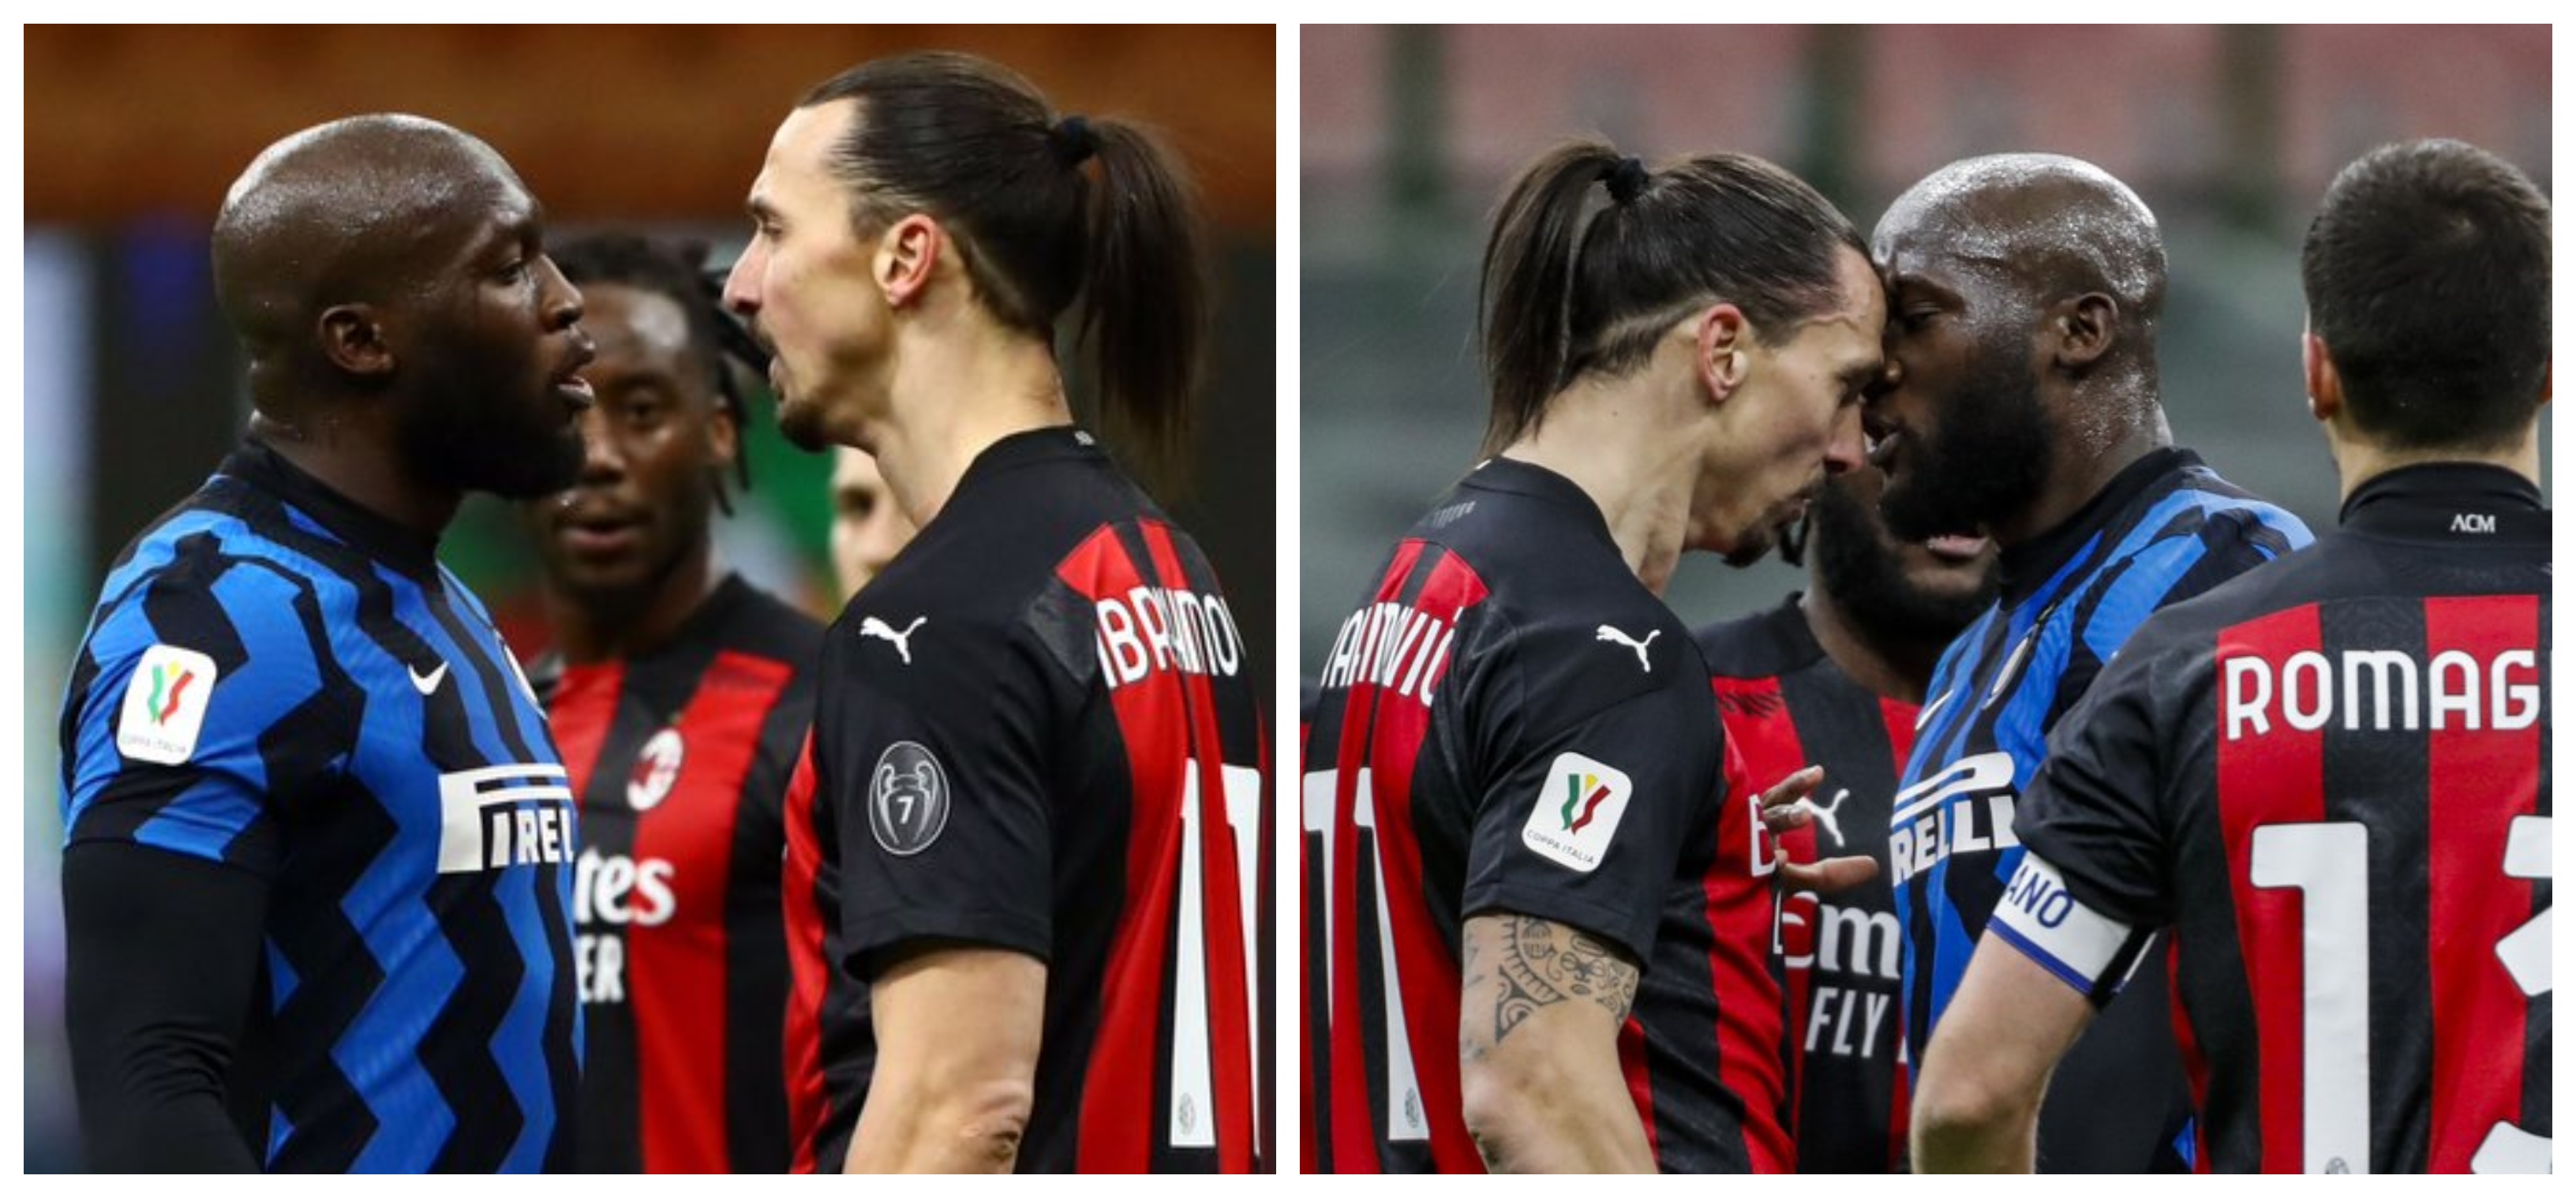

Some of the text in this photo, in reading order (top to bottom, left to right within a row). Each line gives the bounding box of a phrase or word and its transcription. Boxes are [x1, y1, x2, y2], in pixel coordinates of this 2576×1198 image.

[2451, 514, 2496, 533] ACM
[2226, 650, 2553, 740] ROMAG
[897, 796, 915, 824] 7
[1805, 986, 1890, 1058] FLY
